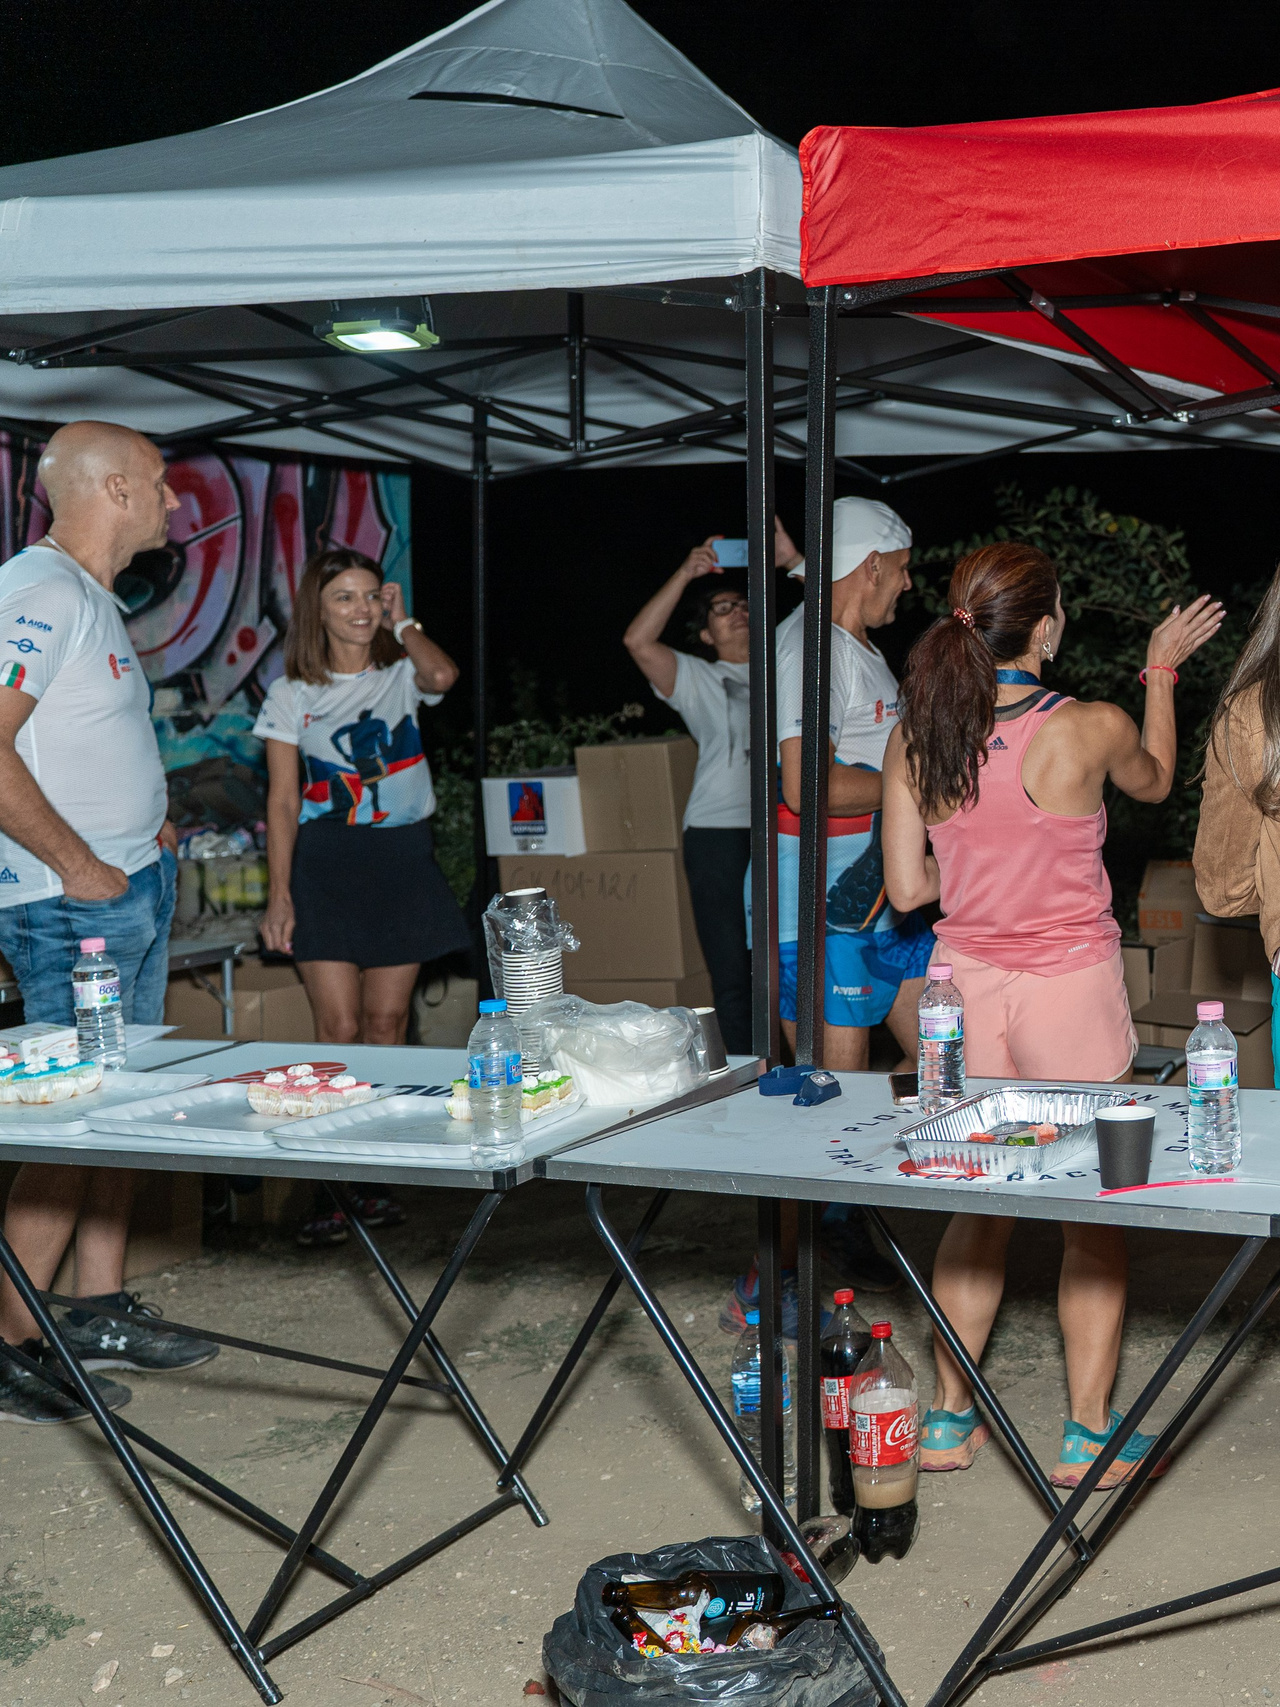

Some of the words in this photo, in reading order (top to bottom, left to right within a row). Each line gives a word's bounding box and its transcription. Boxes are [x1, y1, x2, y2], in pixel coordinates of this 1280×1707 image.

[825, 1148, 883, 1173] TRAIL
[870, 1414, 877, 1424] МЕ
[871, 1425, 879, 1466] РЕЦИКЛИРАЙ
